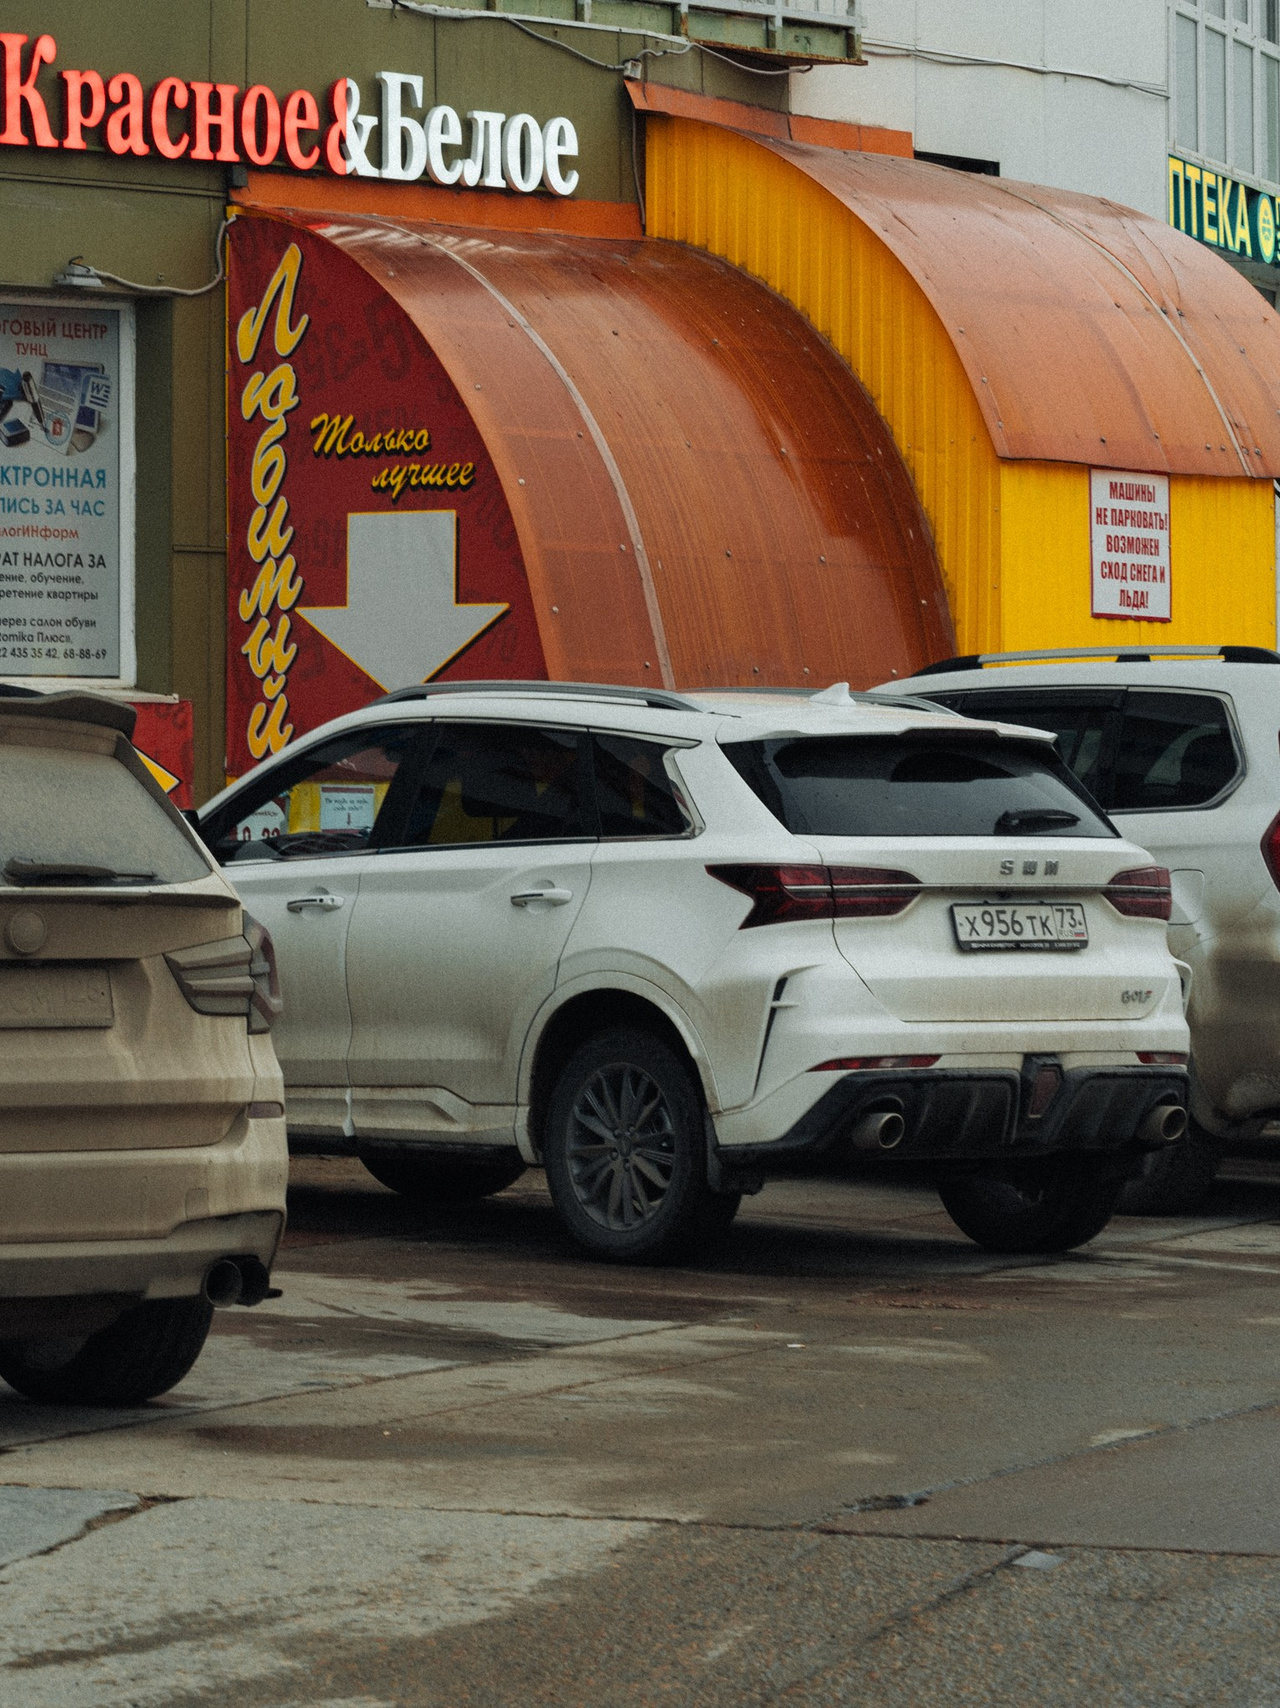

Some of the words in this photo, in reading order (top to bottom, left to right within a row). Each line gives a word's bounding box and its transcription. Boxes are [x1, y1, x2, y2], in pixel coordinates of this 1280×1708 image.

[62, 323, 109, 340] ЦЕНТР
[15, 342, 48, 358] ТУНЦ
[310, 412, 431, 455] Только
[371, 460, 475, 500] лучшее
[1109, 481, 1156, 504] МАШИНЫ
[45, 499, 66, 516] ЗА
[71, 500, 106, 517] ЧАС
[1096, 507, 1108, 526] НЕ
[1111, 508, 1168, 532] ПАРКОВАТЬ!
[1106, 534, 1160, 557] ВОЗМОЖЕН
[23, 552, 84, 568] НАЛОГА
[88, 553, 106, 569] ЗА
[1100, 561, 1128, 584] СХОД
[1130, 563, 1158, 584] СНЕГА
[1160, 566, 1166, 584] И
[47, 590, 99, 602] квартиры
[1119, 589, 1149, 611] ЛЬДА!
[30, 618, 63, 627] салон
[65, 615, 97, 630] обуви
[10, 647, 28, 659] 435
[31, 648, 43, 659] 35
[63, 648, 107, 660] 68-88-69
[1055, 908, 1077, 928] 73
